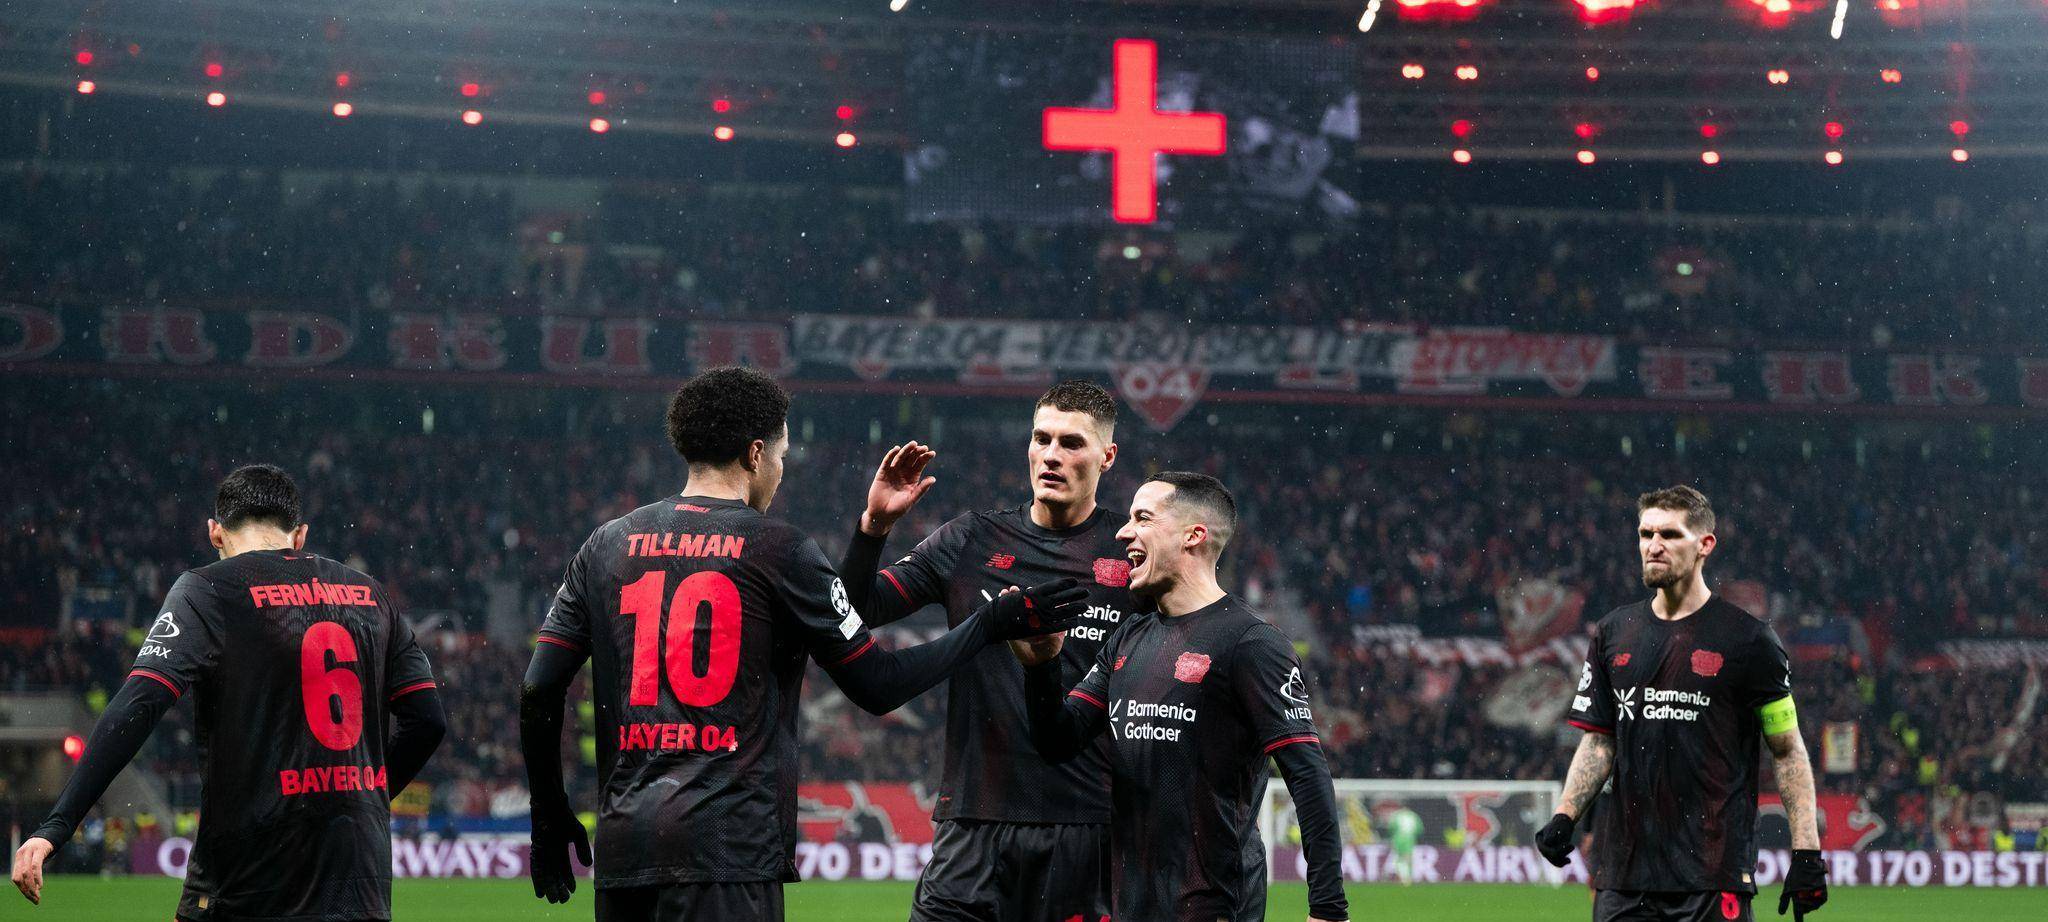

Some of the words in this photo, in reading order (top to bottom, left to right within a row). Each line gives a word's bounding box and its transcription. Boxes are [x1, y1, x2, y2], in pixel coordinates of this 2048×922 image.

[1121, 364, 1195, 400] 04
[627, 532, 745, 559] TILLMAN
[249, 577, 377, 609] FERNÁNDEZ
[138, 645, 172, 659] EDAX
[620, 570, 743, 707] 10
[301, 621, 363, 752] 6
[1644, 687, 1711, 707] Barmenia
[1127, 699, 1197, 722] Barmenia
[1284, 707, 1313, 721] NIED
[701, 725, 739, 752] 04
[1124, 722, 1181, 742] Gothaer
[280, 766, 363, 796] BAYER
[363, 763, 387, 792] 04
[796, 844, 850, 881] 70
[1868, 851, 1928, 887] 170
[1943, 851, 2048, 888] DEST
